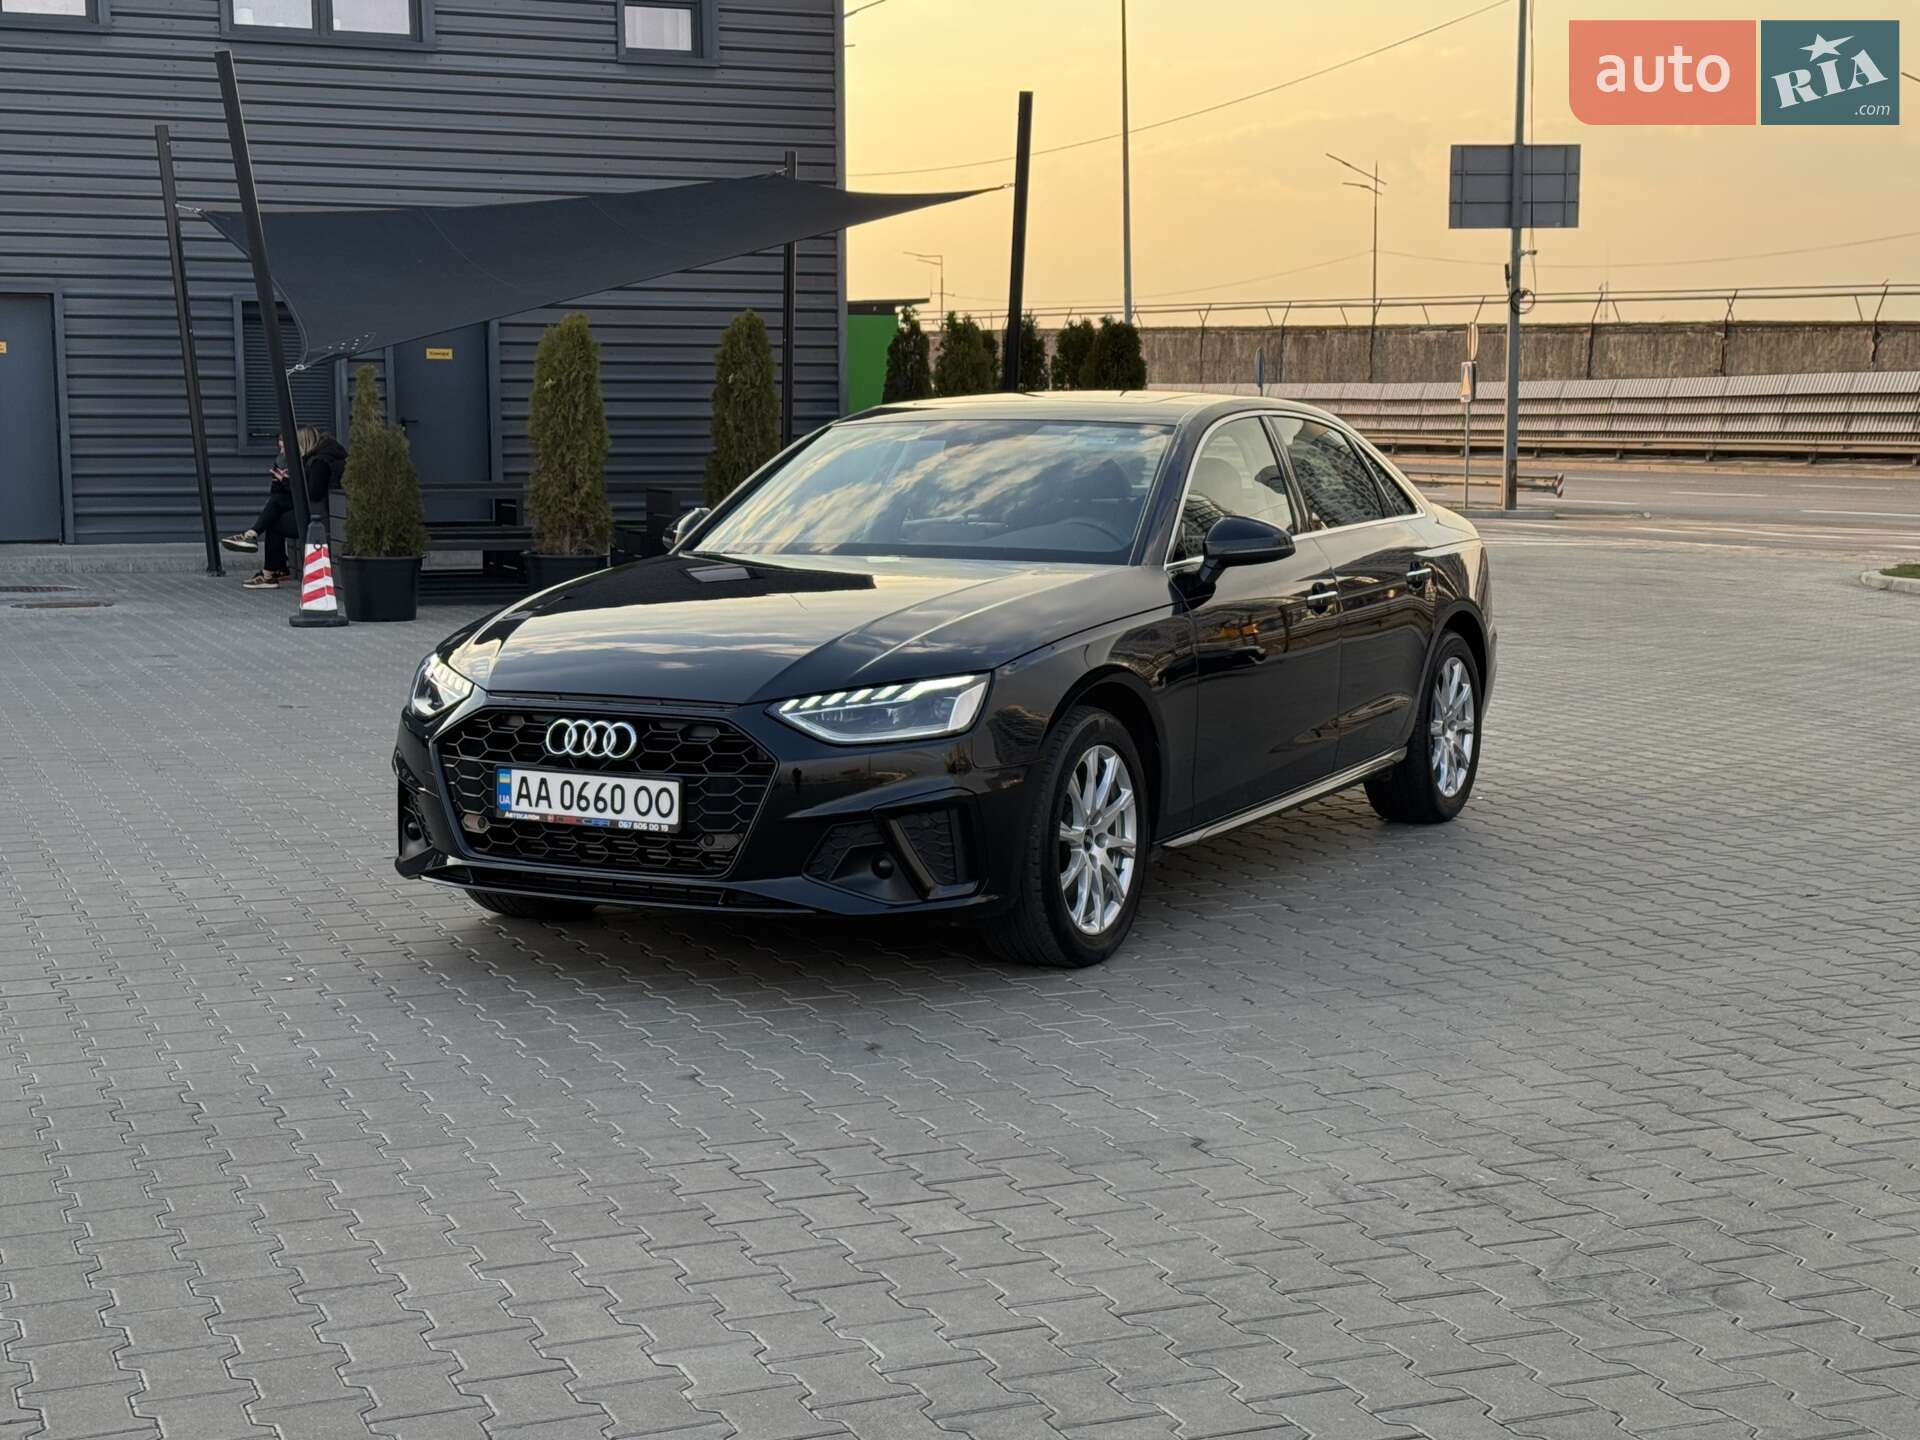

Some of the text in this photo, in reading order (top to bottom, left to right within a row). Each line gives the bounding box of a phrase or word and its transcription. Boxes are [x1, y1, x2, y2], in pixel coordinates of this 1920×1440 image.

[499, 795, 511, 804] UA
[515, 775, 553, 809] AA
[559, 779, 626, 815] 0660
